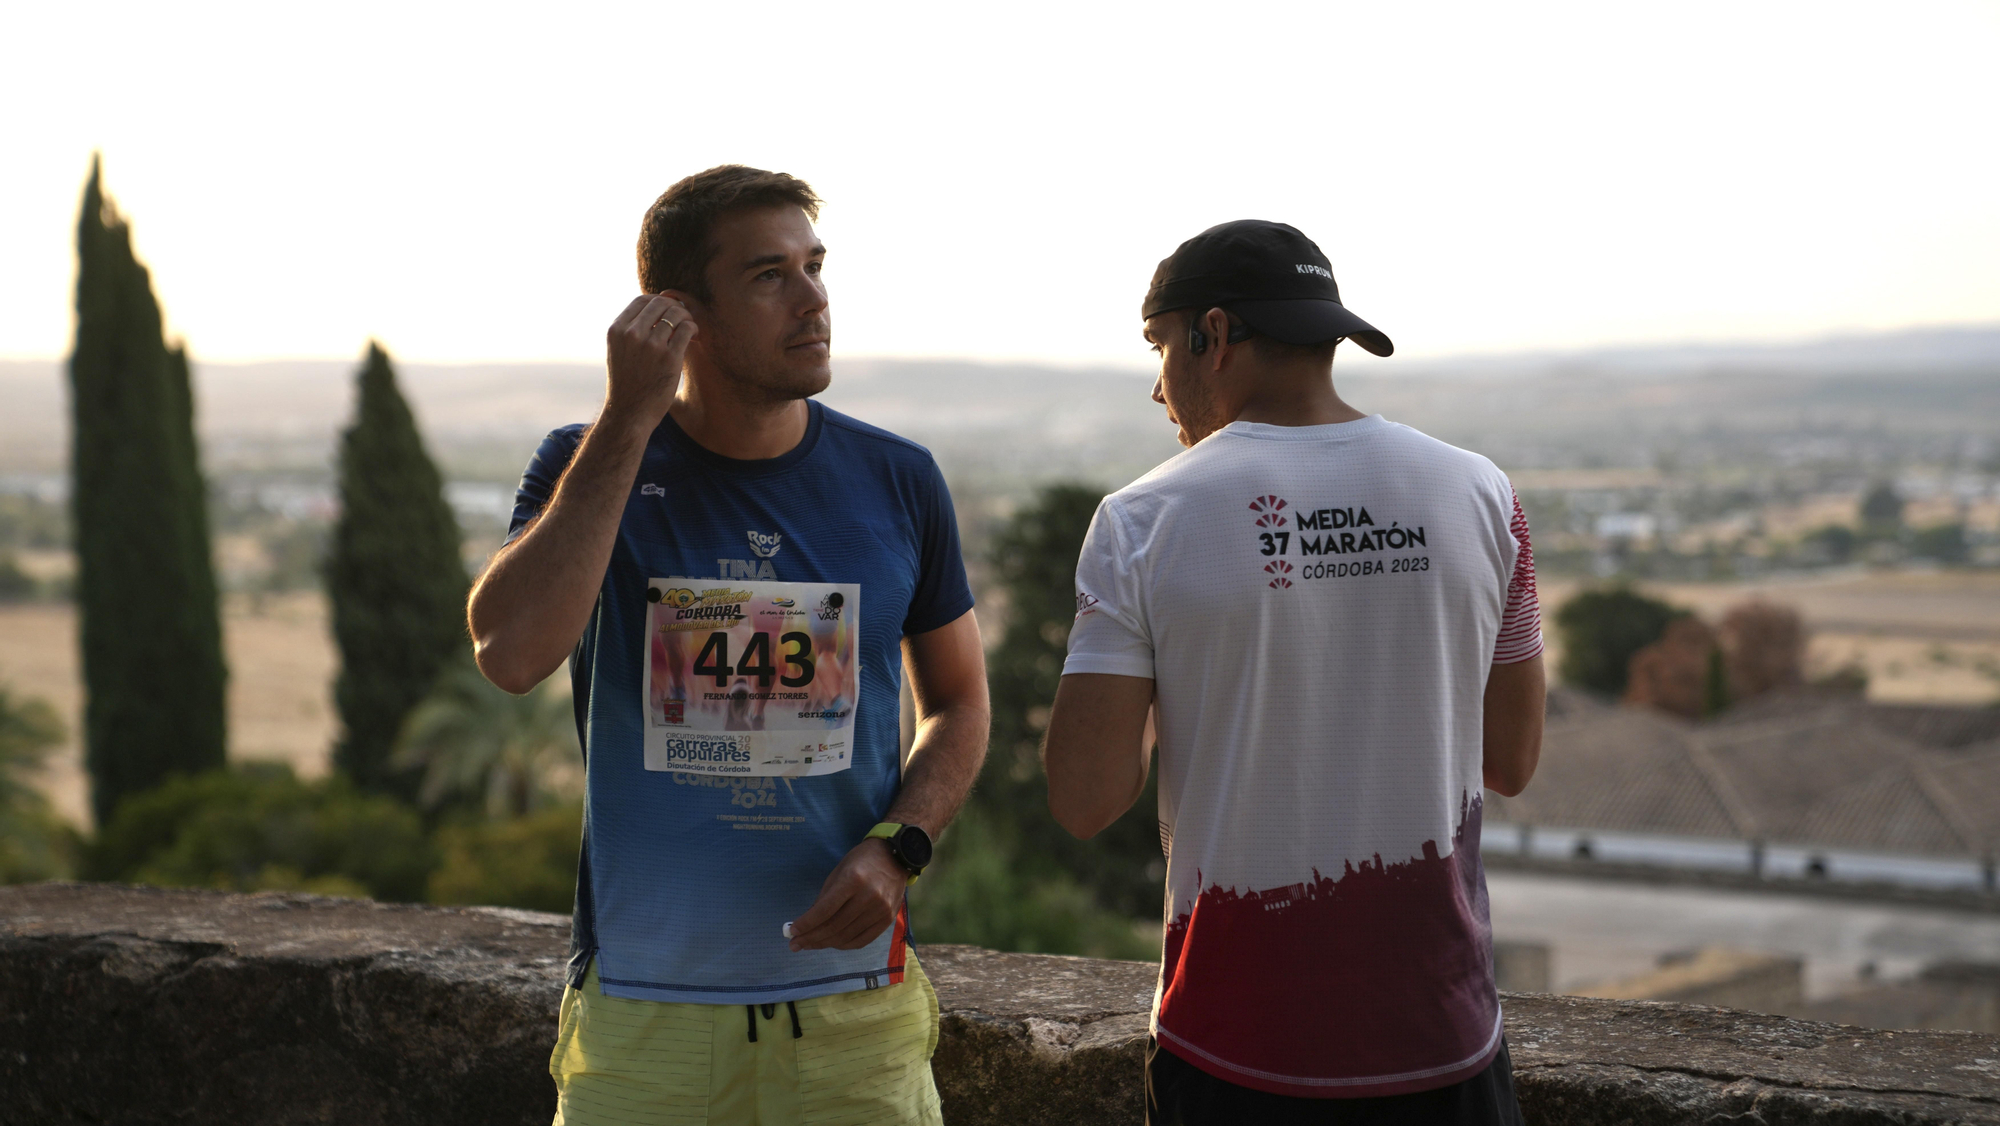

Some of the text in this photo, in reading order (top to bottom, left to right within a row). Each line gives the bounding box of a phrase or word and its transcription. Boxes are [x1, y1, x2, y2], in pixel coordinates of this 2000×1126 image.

[1295, 264, 1332, 279] KIPRUN
[1295, 506, 1375, 531] MEDIA
[1259, 521, 1427, 556] 37 MARATÓN
[717, 558, 778, 579] TINA
[1302, 557, 1430, 580] CÓRDOBA 2023
[660, 587, 731, 609] 40 MEDIA
[699, 590, 753, 606] MARATÓN
[693, 632, 815, 688] 443
[704, 692, 748, 700] FERNANDO
[777, 692, 808, 700] TORRES
[798, 709, 845, 719] serizona
[666, 732, 736, 742] CIRCUITO PROVINCIAL
[738, 735, 751, 743] 20
[666, 739, 737, 752] carreras
[667, 747, 751, 762] populares
[667, 762, 706, 771] Diputación
[718, 765, 751, 773] Córdoba
[730, 788, 777, 809] 2024
